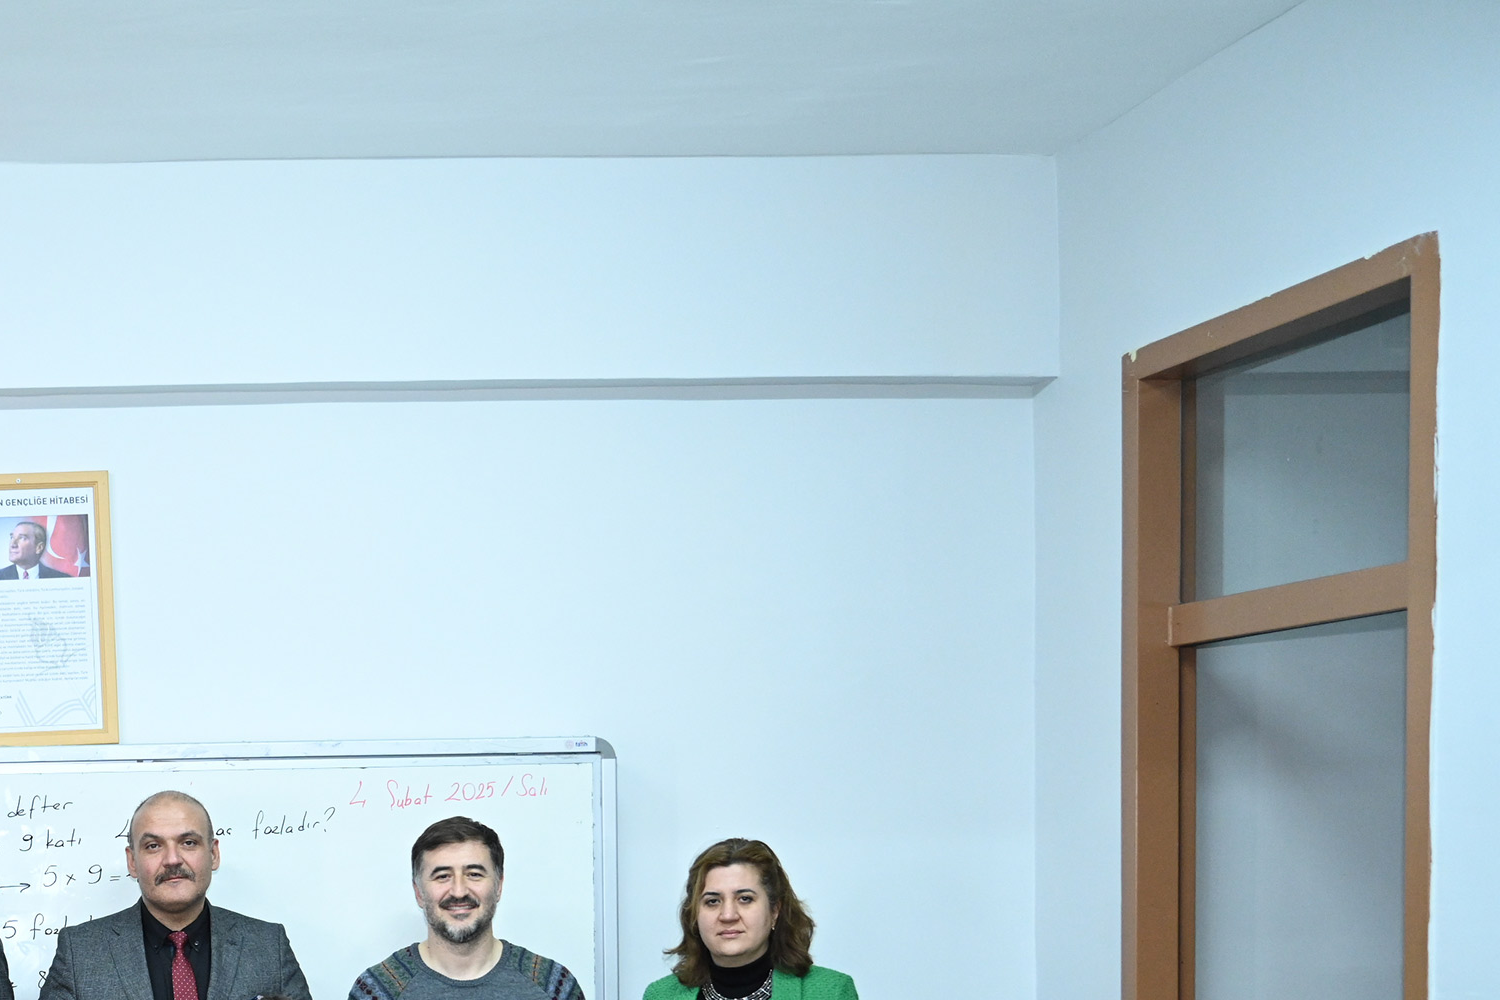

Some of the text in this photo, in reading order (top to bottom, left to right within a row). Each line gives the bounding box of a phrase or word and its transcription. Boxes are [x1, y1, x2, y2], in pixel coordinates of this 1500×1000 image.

[5, 495, 48, 507] GENÇLİĞE
[49, 494, 89, 505] HİTABESİ
[444, 781, 497, 802] 2025
[516, 773, 548, 797] Salı
[7, 795, 74, 819] defter
[19, 834, 34, 852] 9
[46, 828, 82, 850] katı
[43, 864, 58, 888] 5
[87, 863, 103, 885] 9
[2, 919, 19, 939] 5
